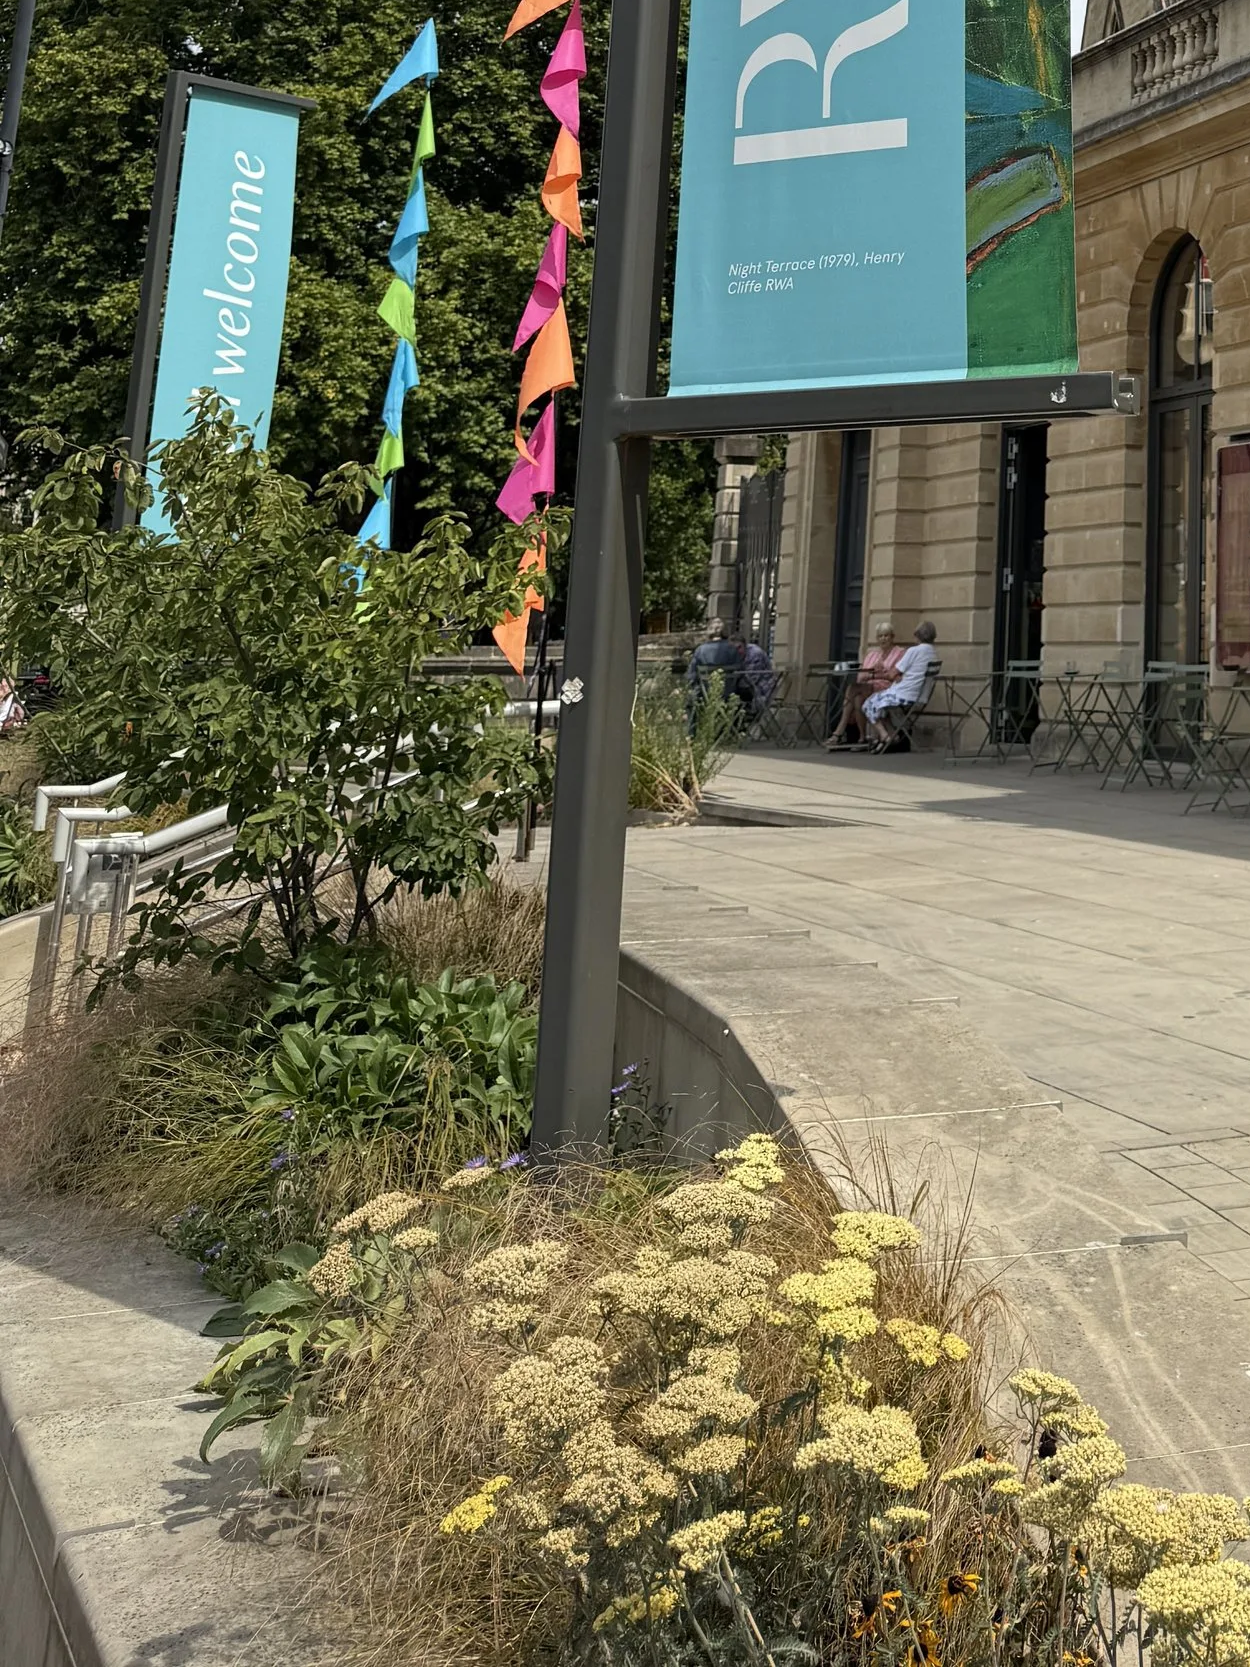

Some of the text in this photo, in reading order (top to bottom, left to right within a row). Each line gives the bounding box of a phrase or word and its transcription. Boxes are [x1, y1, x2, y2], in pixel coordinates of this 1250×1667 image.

[203, 150, 266, 375] welcome
[729, 251, 906, 279] Night Terrace (1979), Henry
[728, 276, 794, 295] Cliffe RWA
